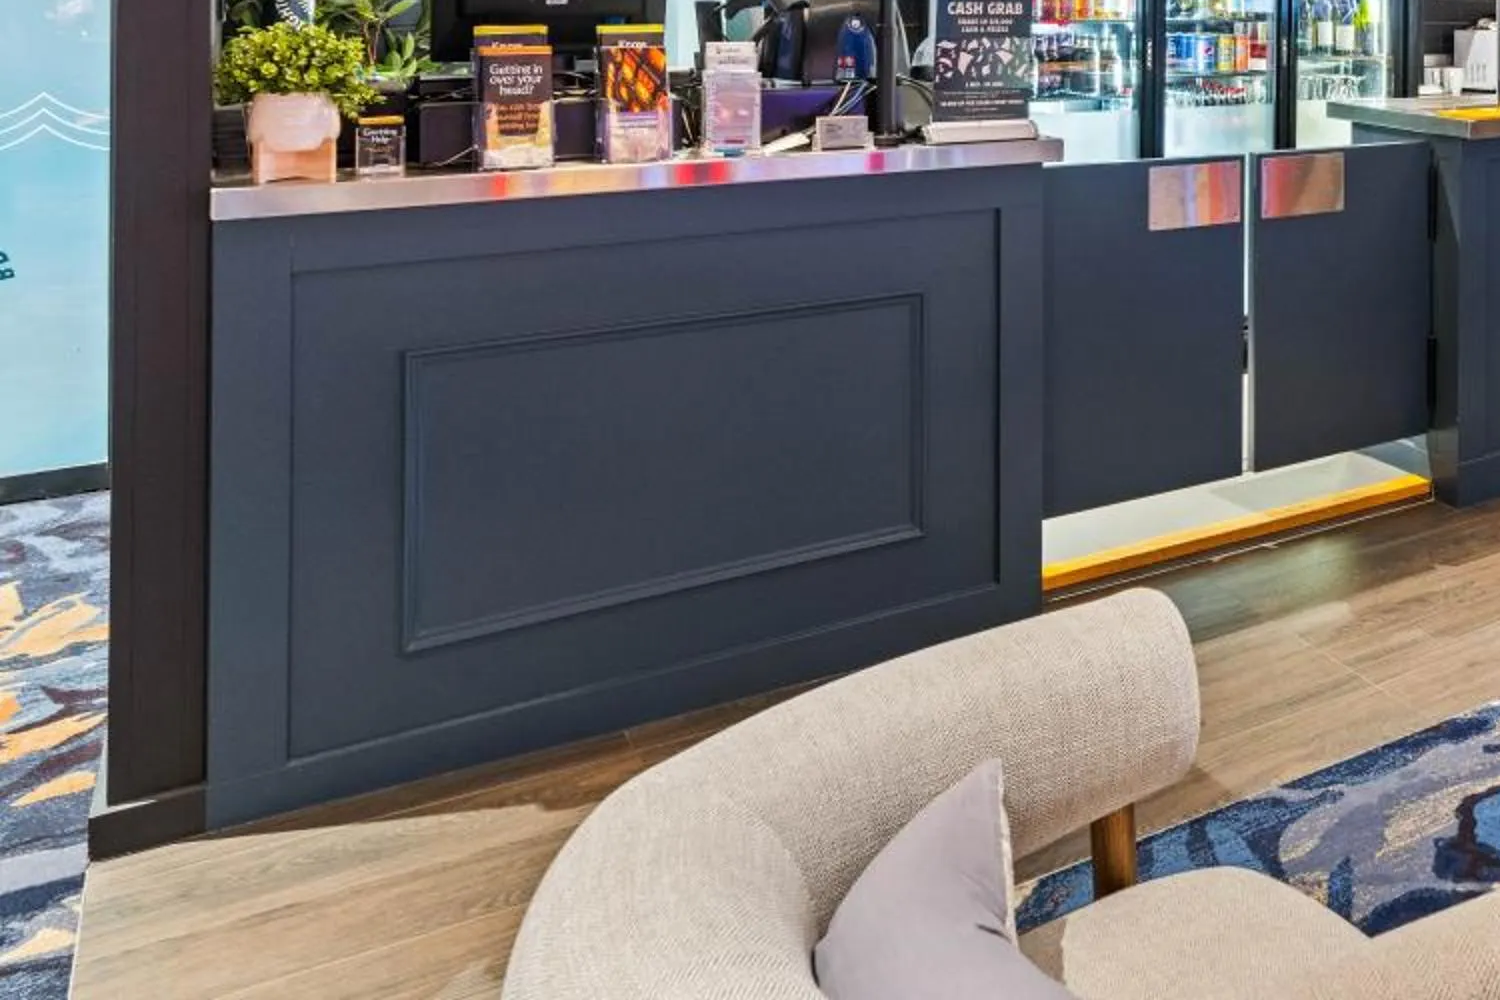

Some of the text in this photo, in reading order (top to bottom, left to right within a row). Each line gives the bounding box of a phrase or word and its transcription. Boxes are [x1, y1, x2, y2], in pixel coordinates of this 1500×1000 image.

[947, 1, 1023, 15] CASH GRAB
[489, 63, 543, 77] Getting in
[489, 74, 543, 86] over your
[499, 85, 535, 95] head?
